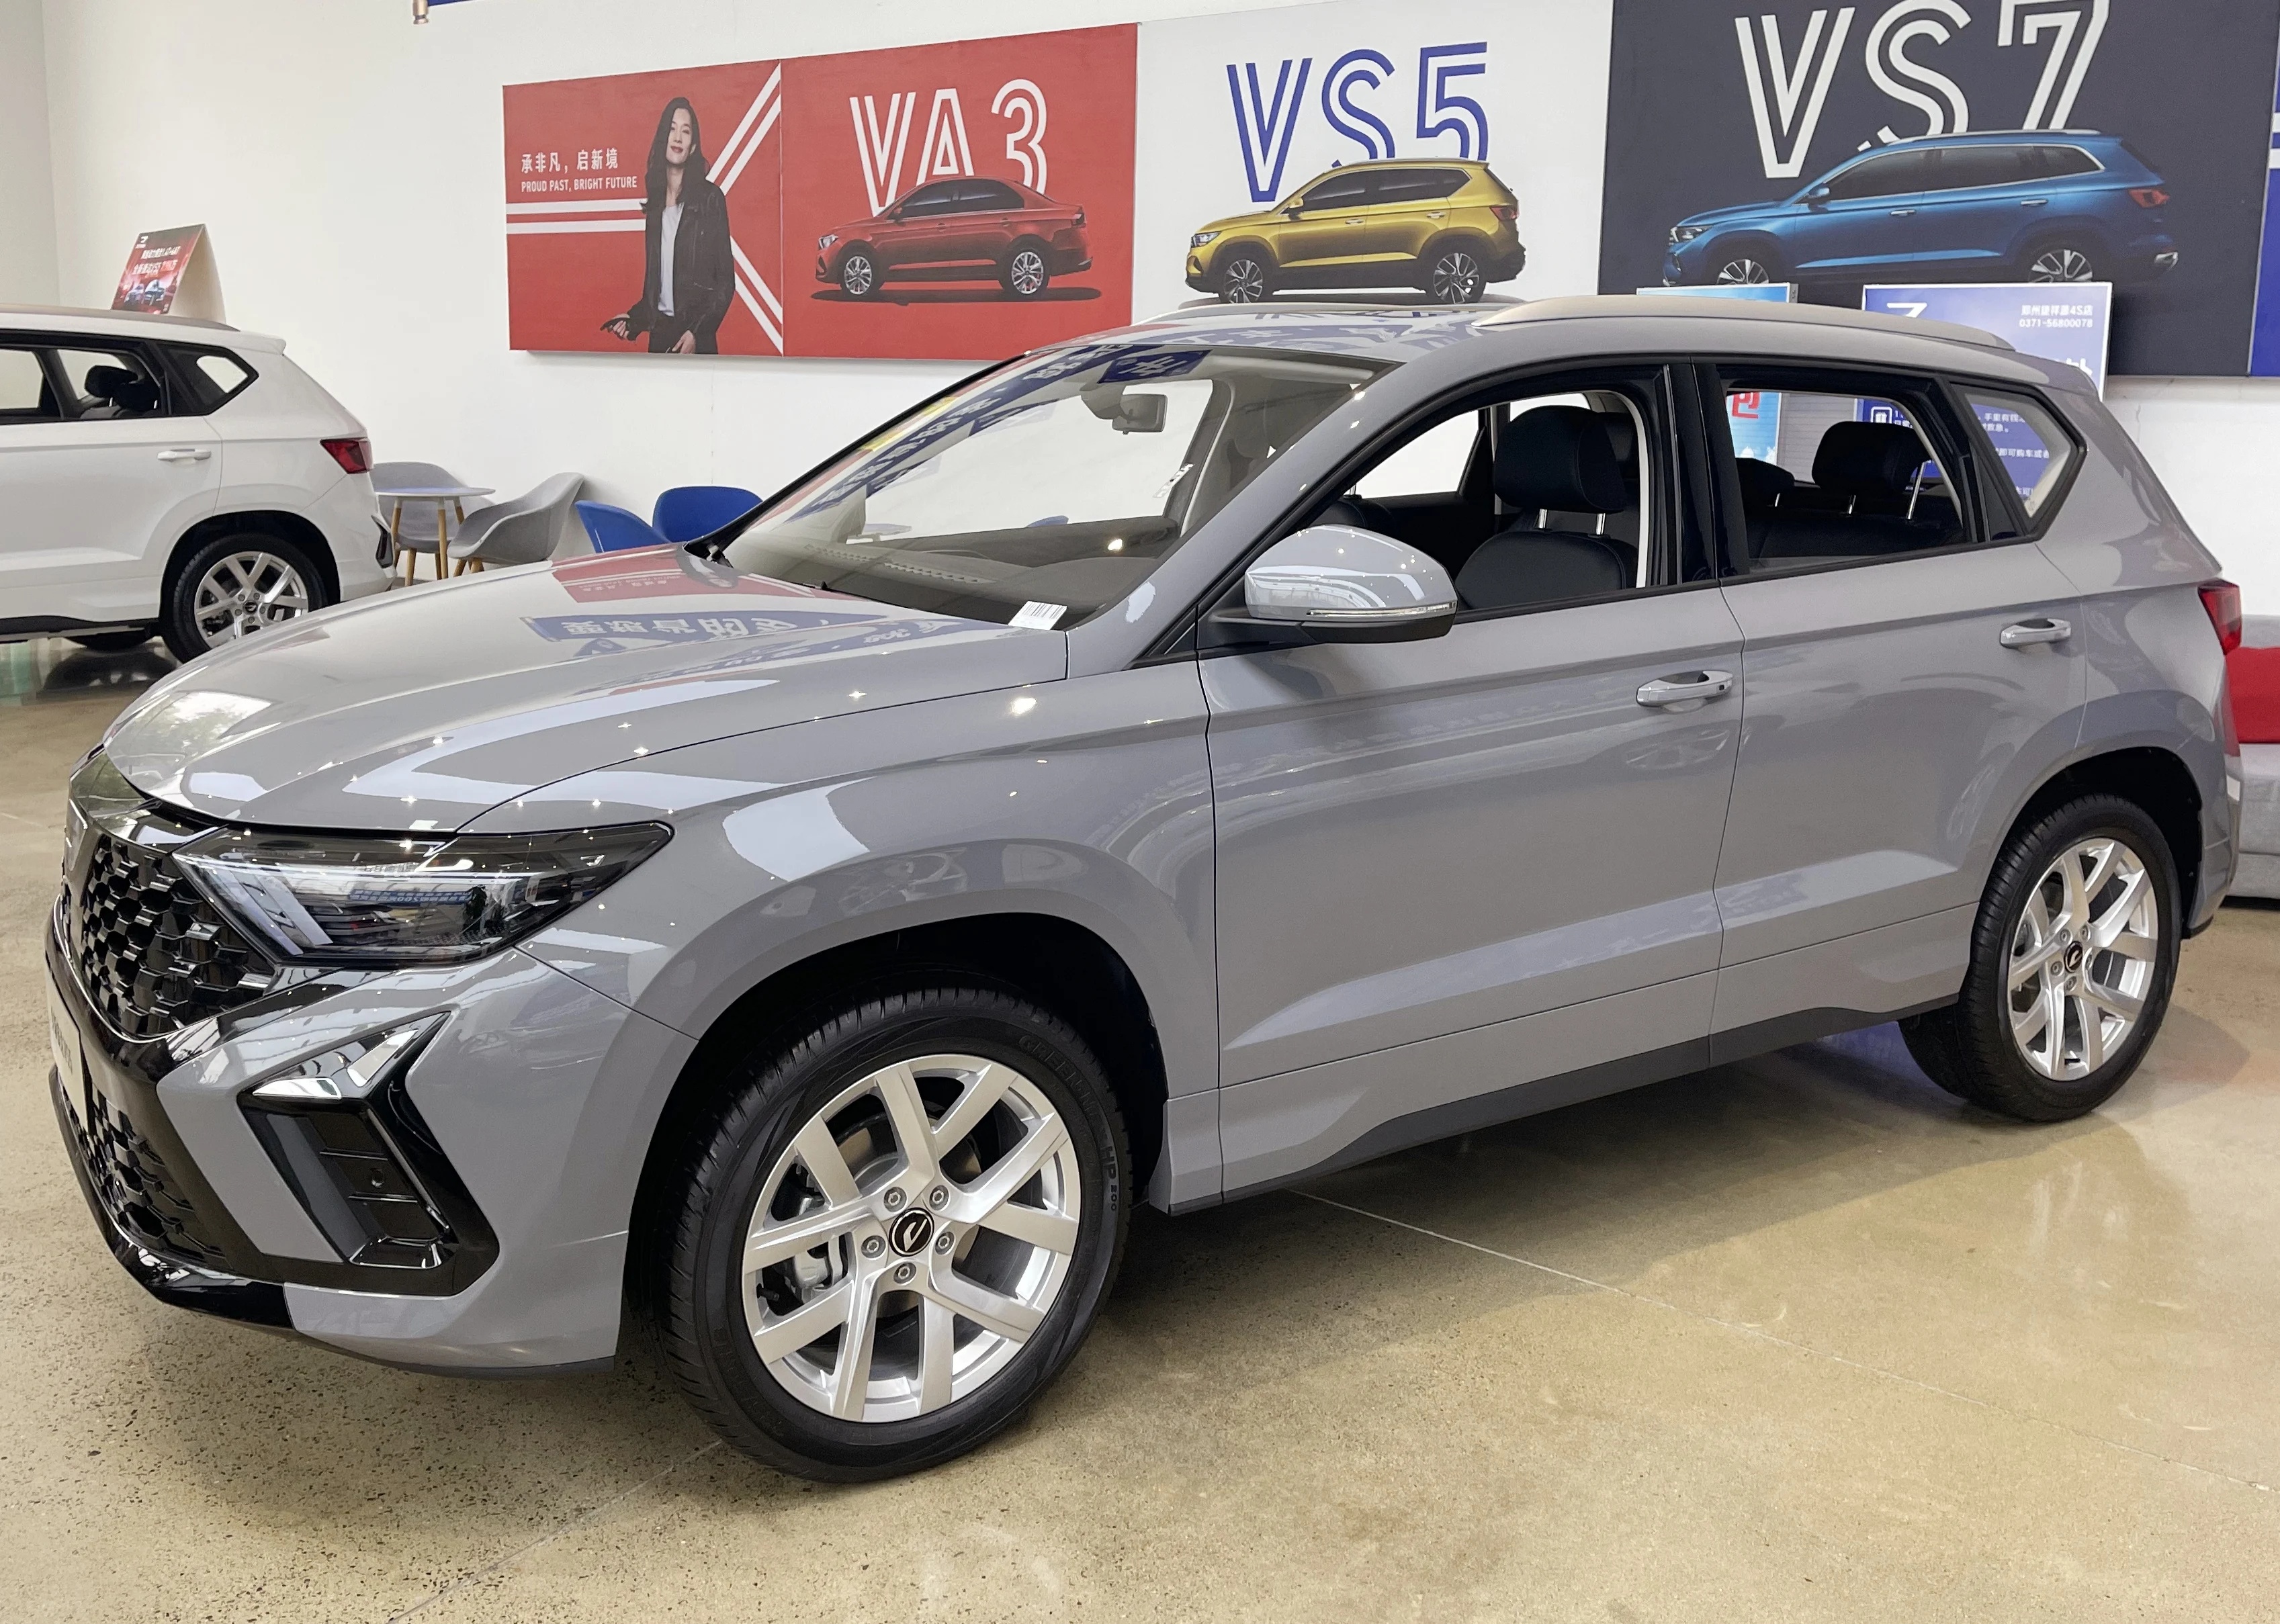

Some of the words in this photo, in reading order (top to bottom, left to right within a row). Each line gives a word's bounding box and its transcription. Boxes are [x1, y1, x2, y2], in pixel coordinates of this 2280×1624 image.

[1227, 42, 1489, 203] VS5
[521, 147, 618, 173] 承非凡，启新境
[521, 181, 547, 192] PROUD
[550, 179, 571, 192] PAST,
[574, 177, 603, 190] BRIGHT
[605, 176, 637, 189] FUTURE
